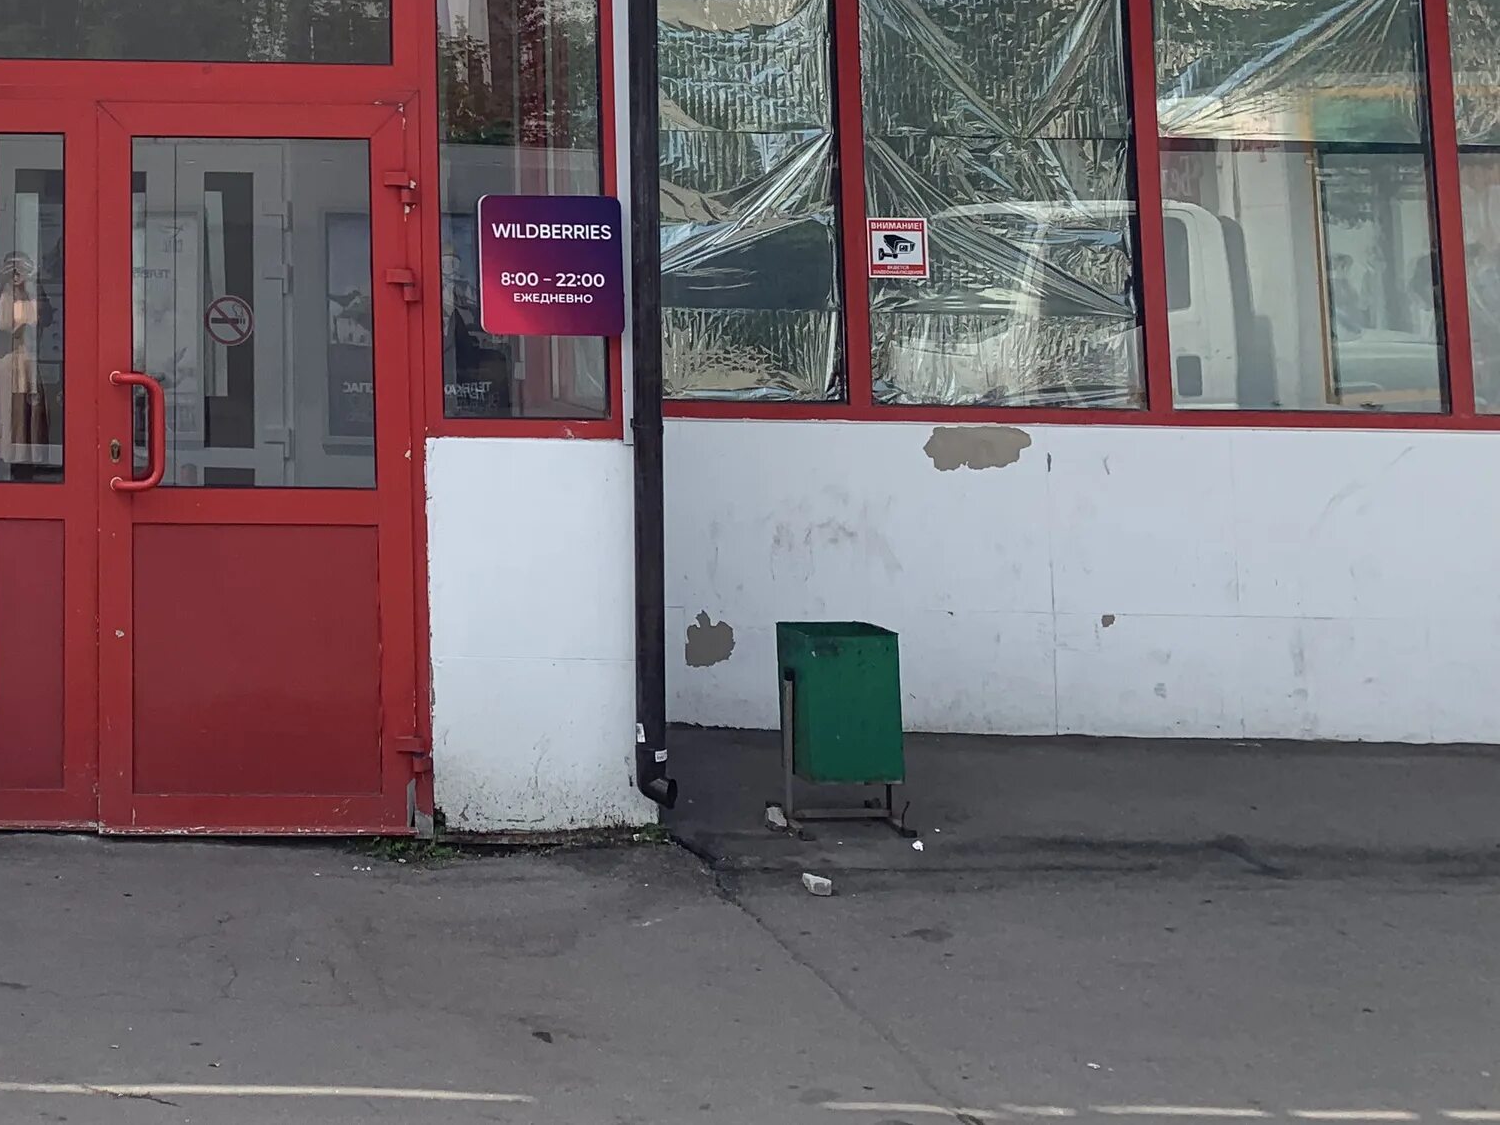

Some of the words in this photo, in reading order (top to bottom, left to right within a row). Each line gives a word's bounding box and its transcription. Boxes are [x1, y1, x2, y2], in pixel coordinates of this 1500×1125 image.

[492, 223, 612, 240] WILDBERRIES
[871, 222, 922, 230] ВНИМАНИЕ!
[501, 272, 538, 286] 8:00
[555, 273, 605, 287] 22:00
[513, 293, 593, 304] ЕЖЕДНЕВНО
